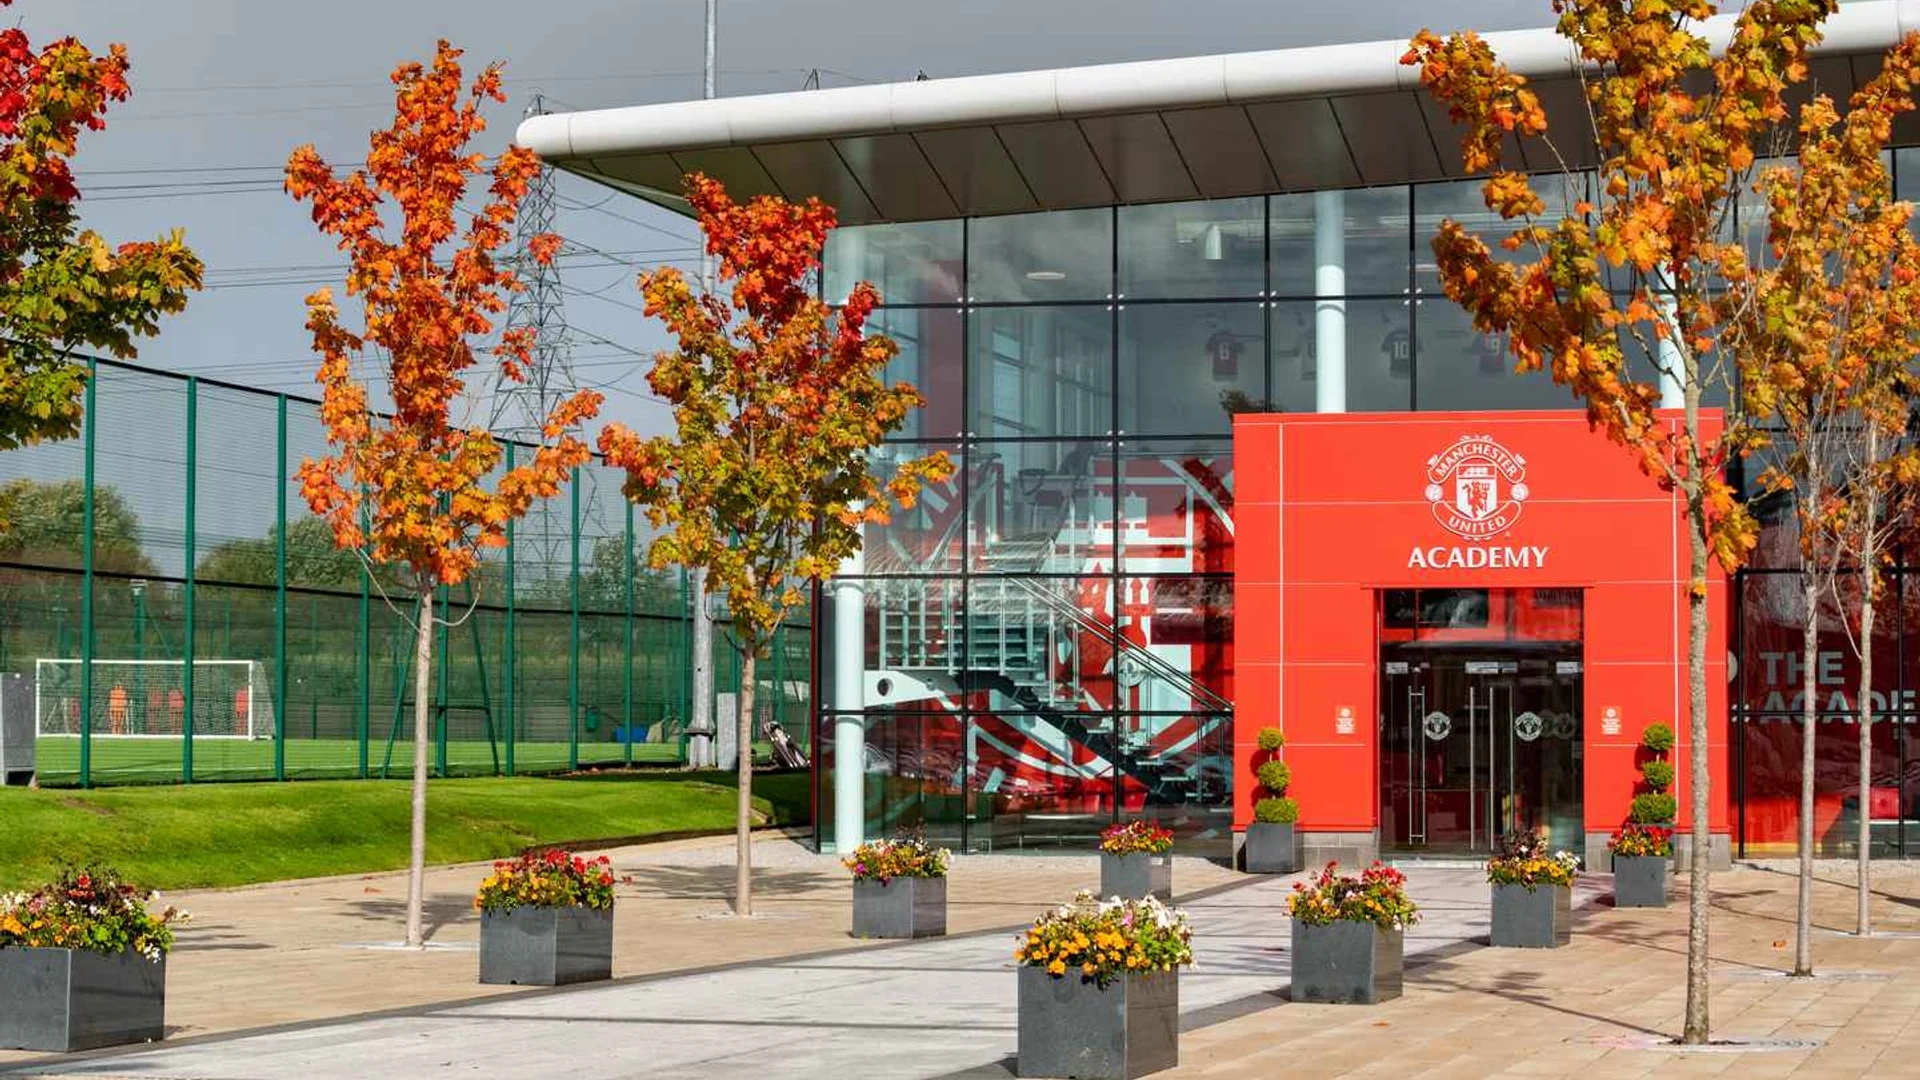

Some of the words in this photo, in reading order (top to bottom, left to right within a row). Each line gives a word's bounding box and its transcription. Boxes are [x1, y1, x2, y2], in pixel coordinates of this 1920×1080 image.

[1392, 341, 1409, 359] 10
[1435, 443, 1518, 477] MANCHESTER
[1448, 515, 1506, 534] UNITED
[1408, 546, 1550, 569] ACADEMY
[1759, 651, 1845, 685] THE
